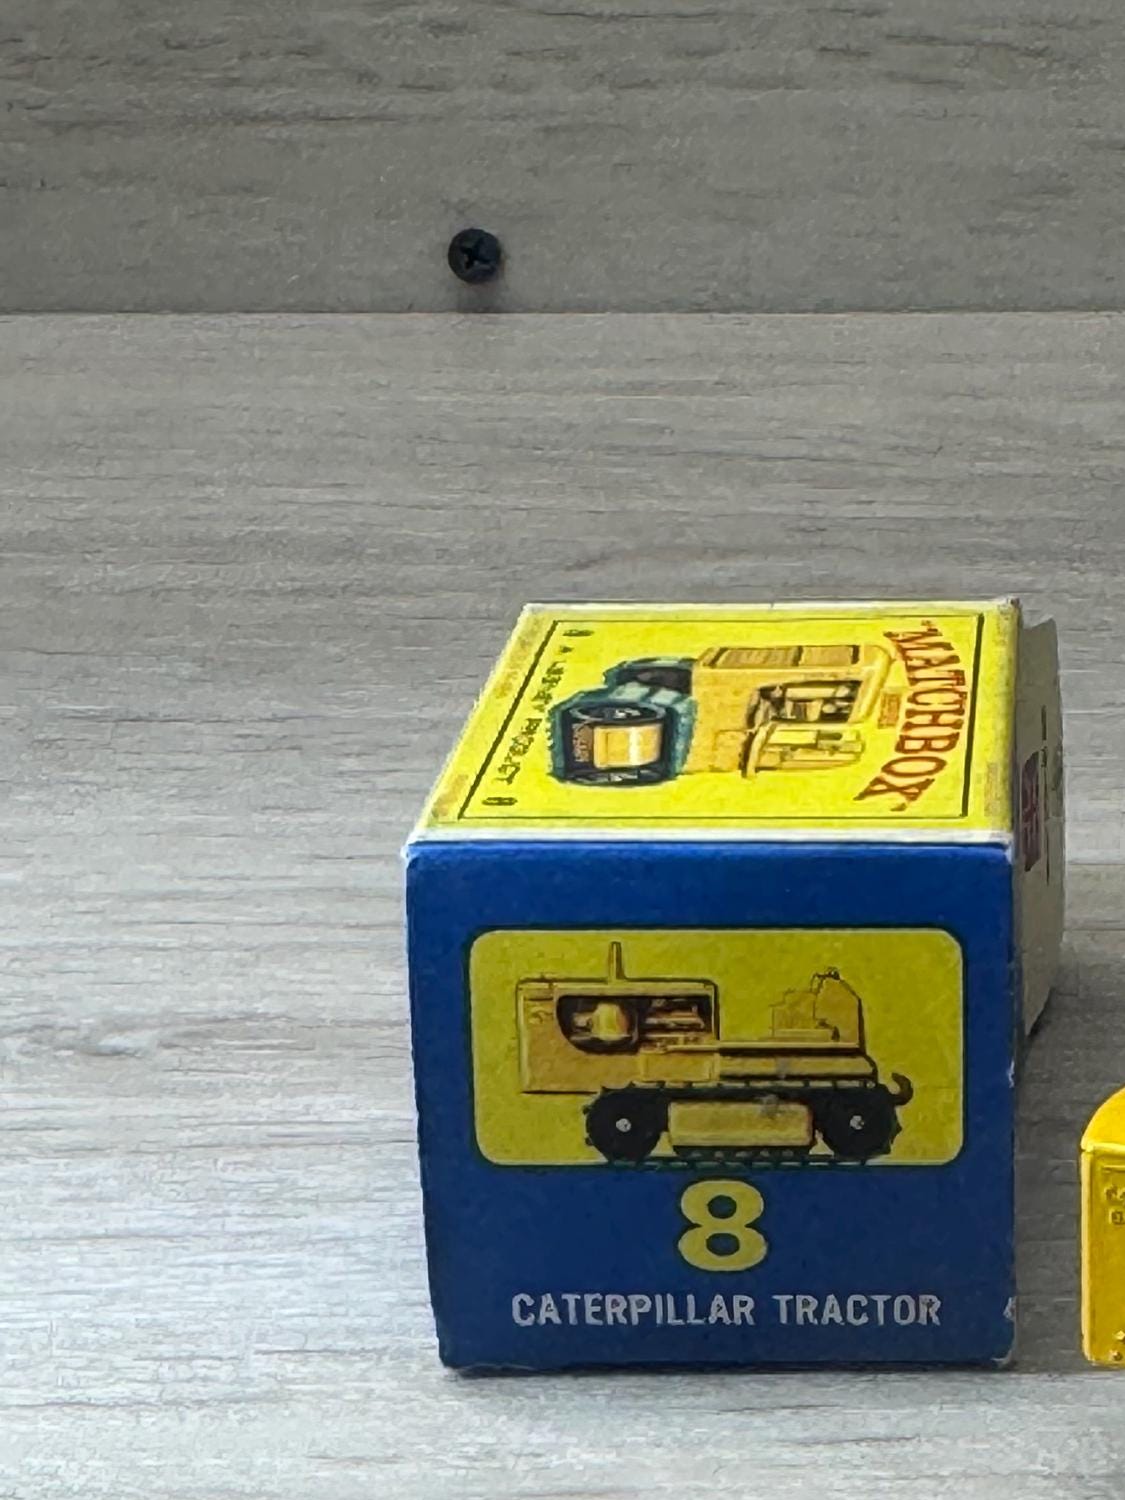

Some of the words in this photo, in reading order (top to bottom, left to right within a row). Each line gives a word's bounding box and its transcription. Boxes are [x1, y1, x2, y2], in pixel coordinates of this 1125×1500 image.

[677, 1179, 768, 1273] 8
[510, 1293, 756, 1327] CATERPILLAR
[772, 1293, 942, 1327] TRACTOR
